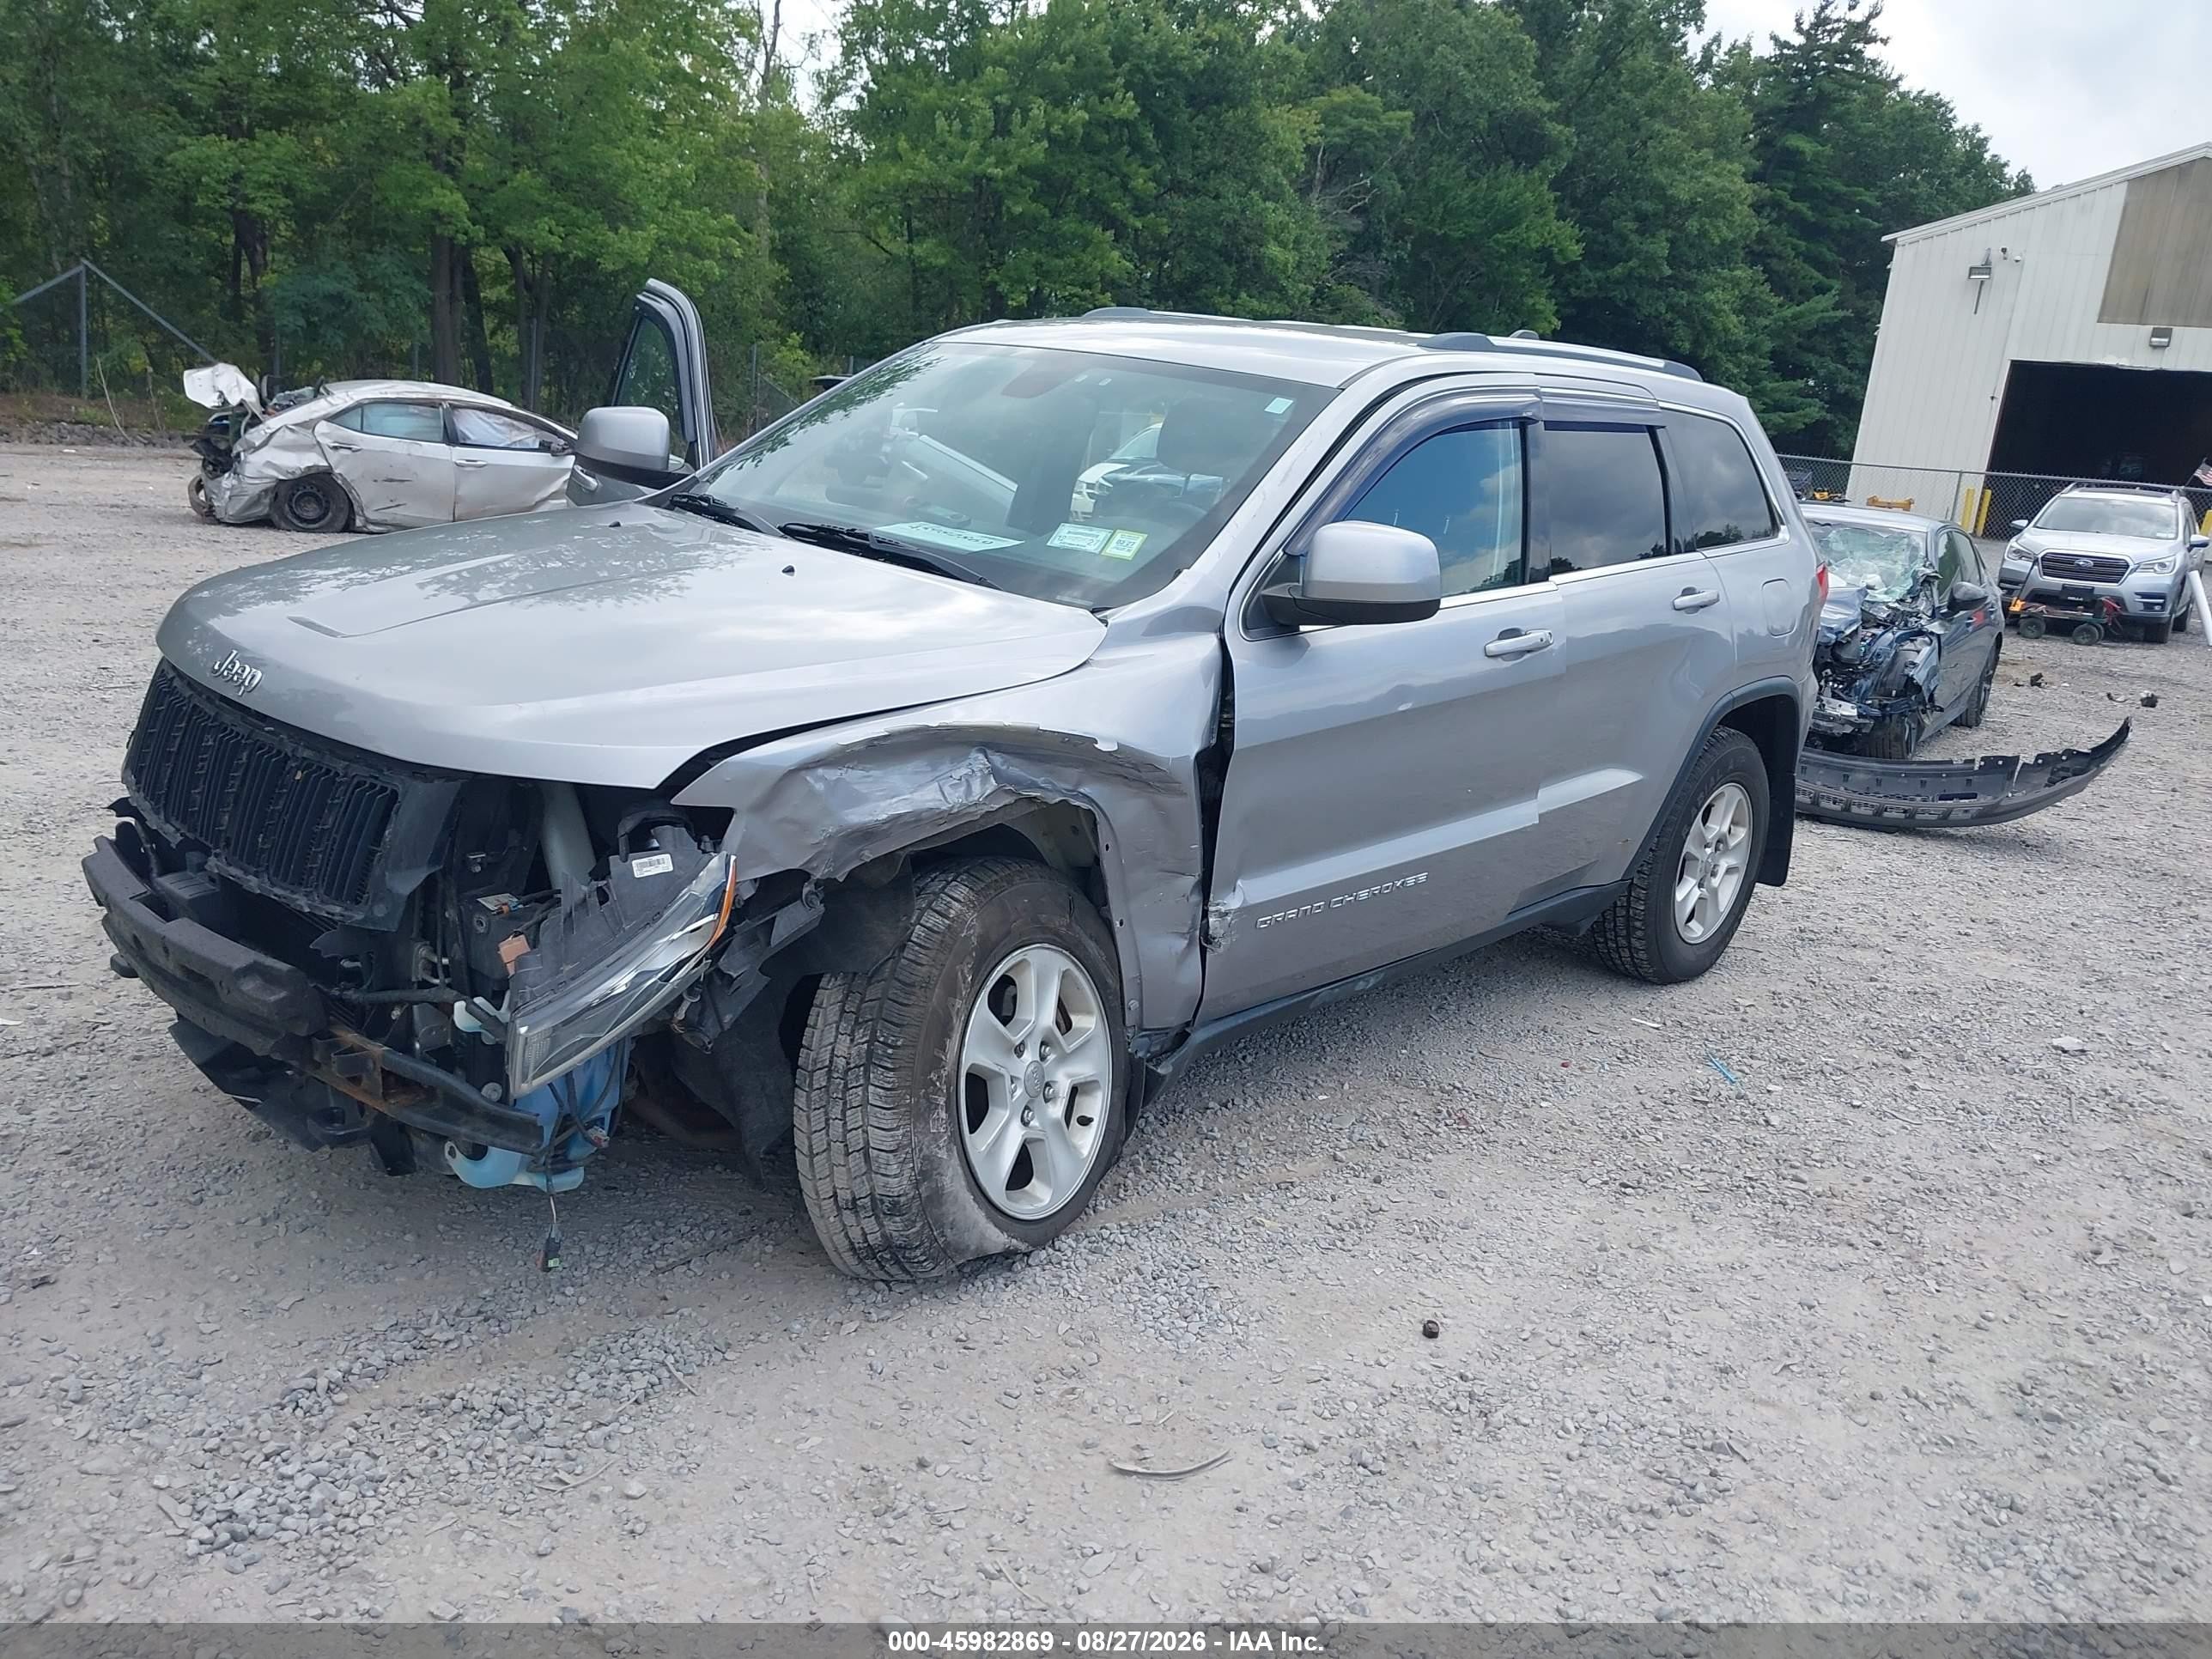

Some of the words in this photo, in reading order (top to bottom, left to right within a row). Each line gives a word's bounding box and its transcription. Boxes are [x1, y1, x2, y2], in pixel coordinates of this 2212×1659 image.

[213, 649, 263, 696] Jeep
[1255, 901, 1325, 929] GRAND
[1328, 872, 1428, 909] CHEROKEE
